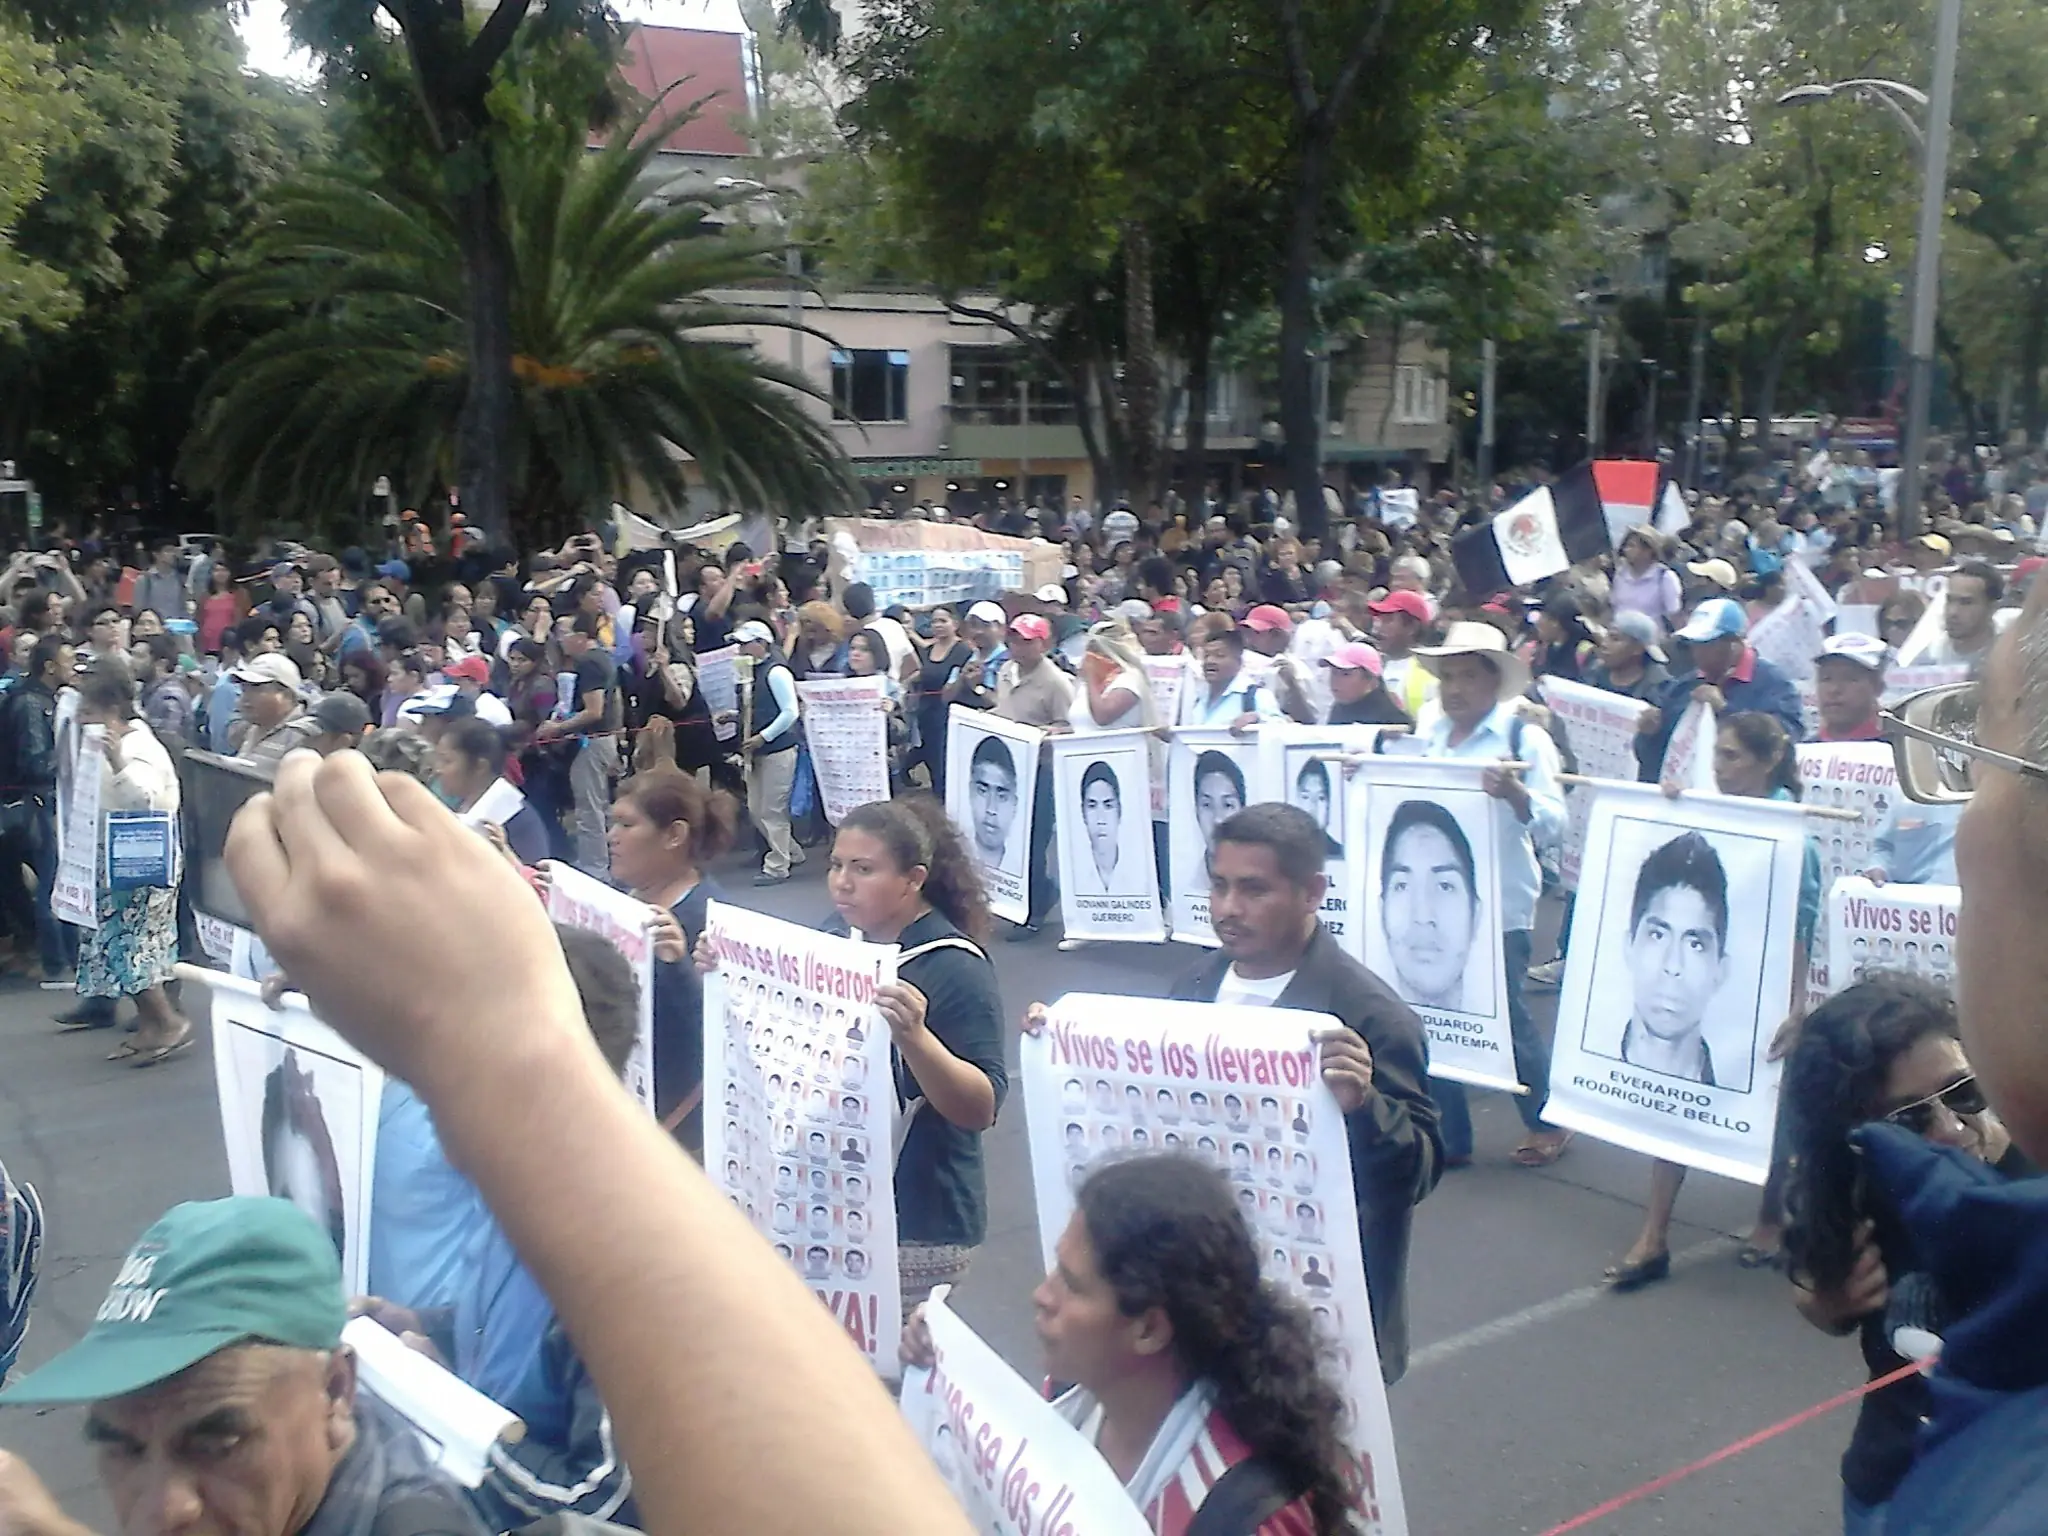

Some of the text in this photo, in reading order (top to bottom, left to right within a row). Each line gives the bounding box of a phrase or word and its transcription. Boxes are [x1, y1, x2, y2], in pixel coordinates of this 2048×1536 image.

[1843, 896, 1902, 932] ¡Vivos
[1908, 908, 1932, 935] se
[756, 945, 776, 977] se
[777, 944, 800, 986] los
[1123, 1039, 1153, 1075] se
[1160, 1028, 1199, 1080] los
[1572, 1076, 1751, 1134] RODRIGUEZ BELLO
[1609, 1070, 1712, 1107] EVERARDO
